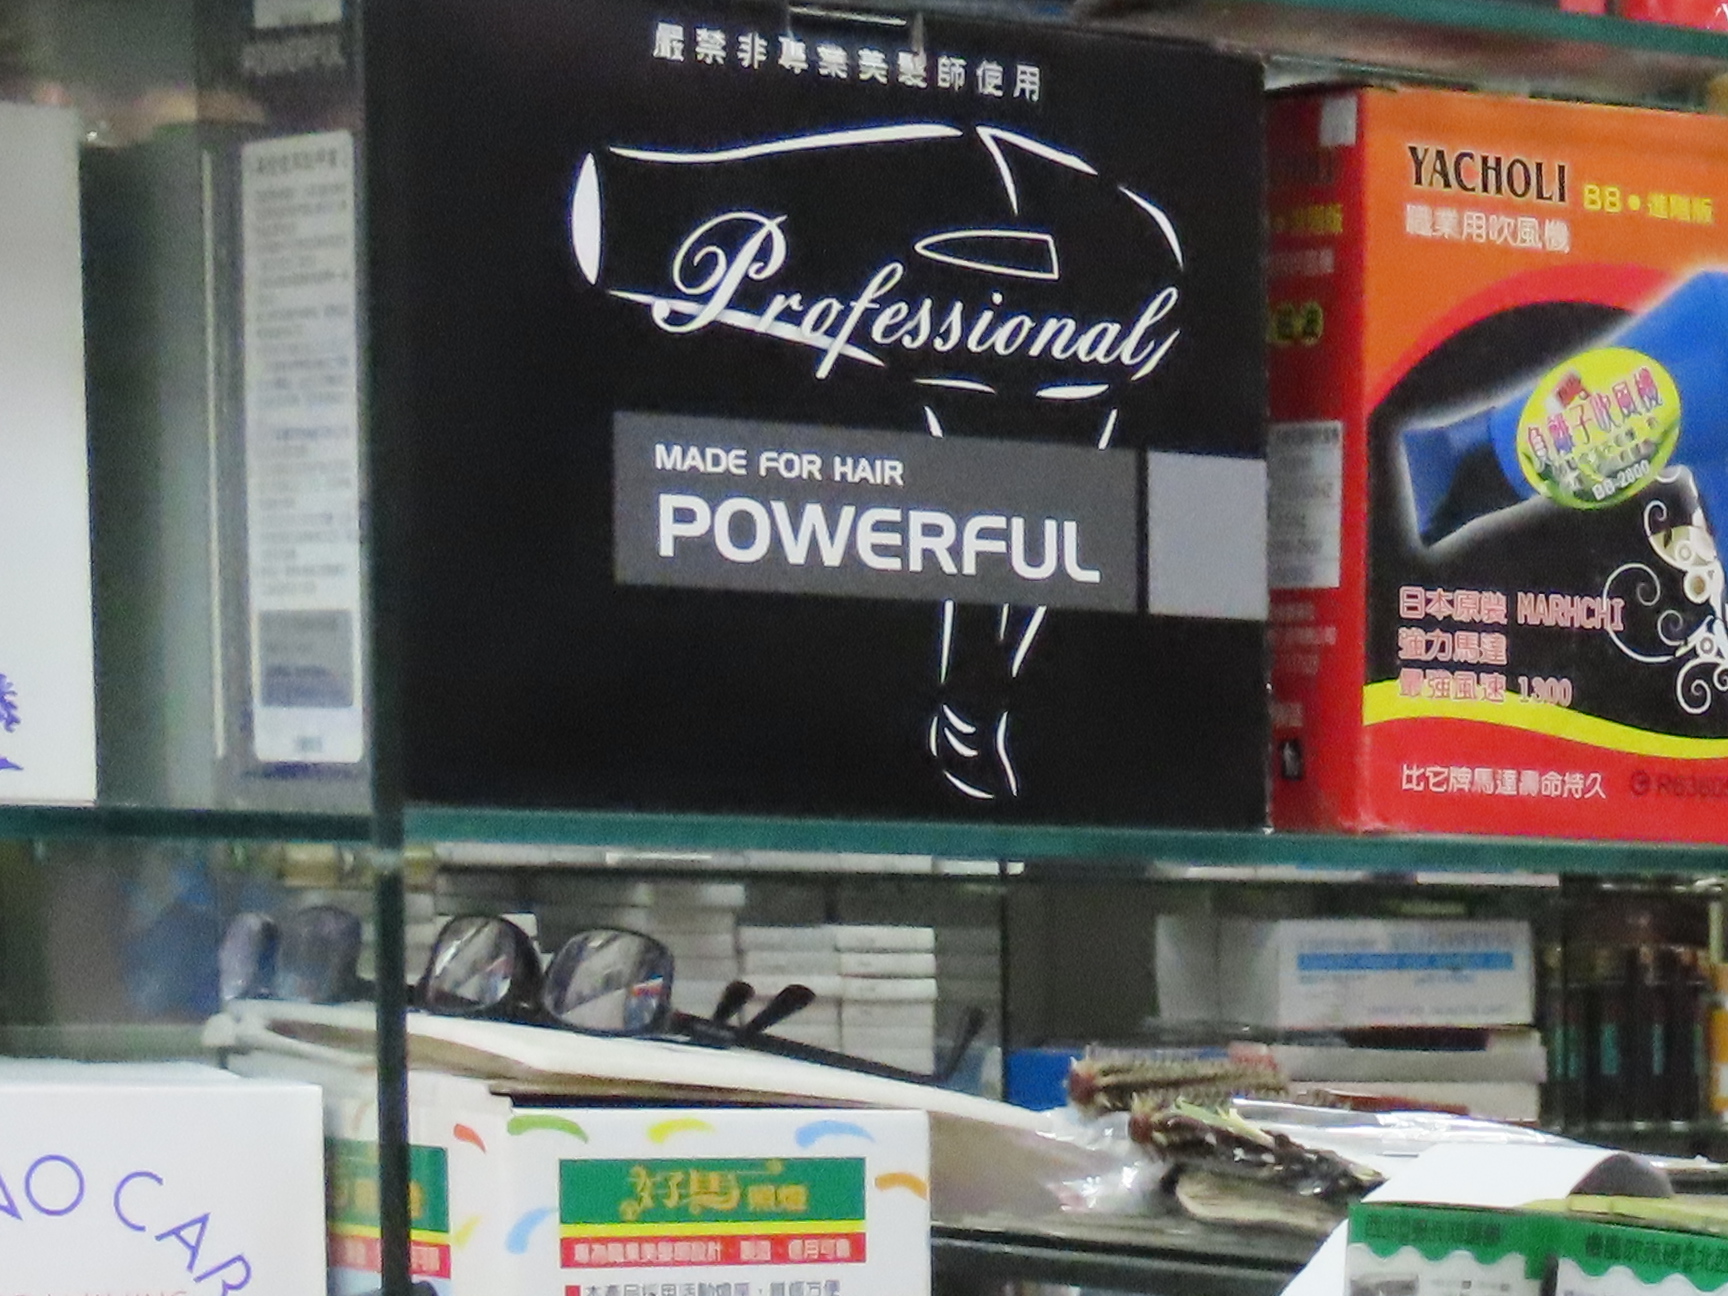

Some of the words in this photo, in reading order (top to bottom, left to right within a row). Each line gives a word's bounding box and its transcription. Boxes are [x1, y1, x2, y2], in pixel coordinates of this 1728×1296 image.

[1406, 144, 1568, 203] YACHOLI
[651, 210, 1181, 381] Professional
[655, 444, 747, 475] MADE
[759, 450, 822, 481] FOR
[833, 456, 905, 486] HAIR
[657, 493, 1101, 584] POWERFUL
